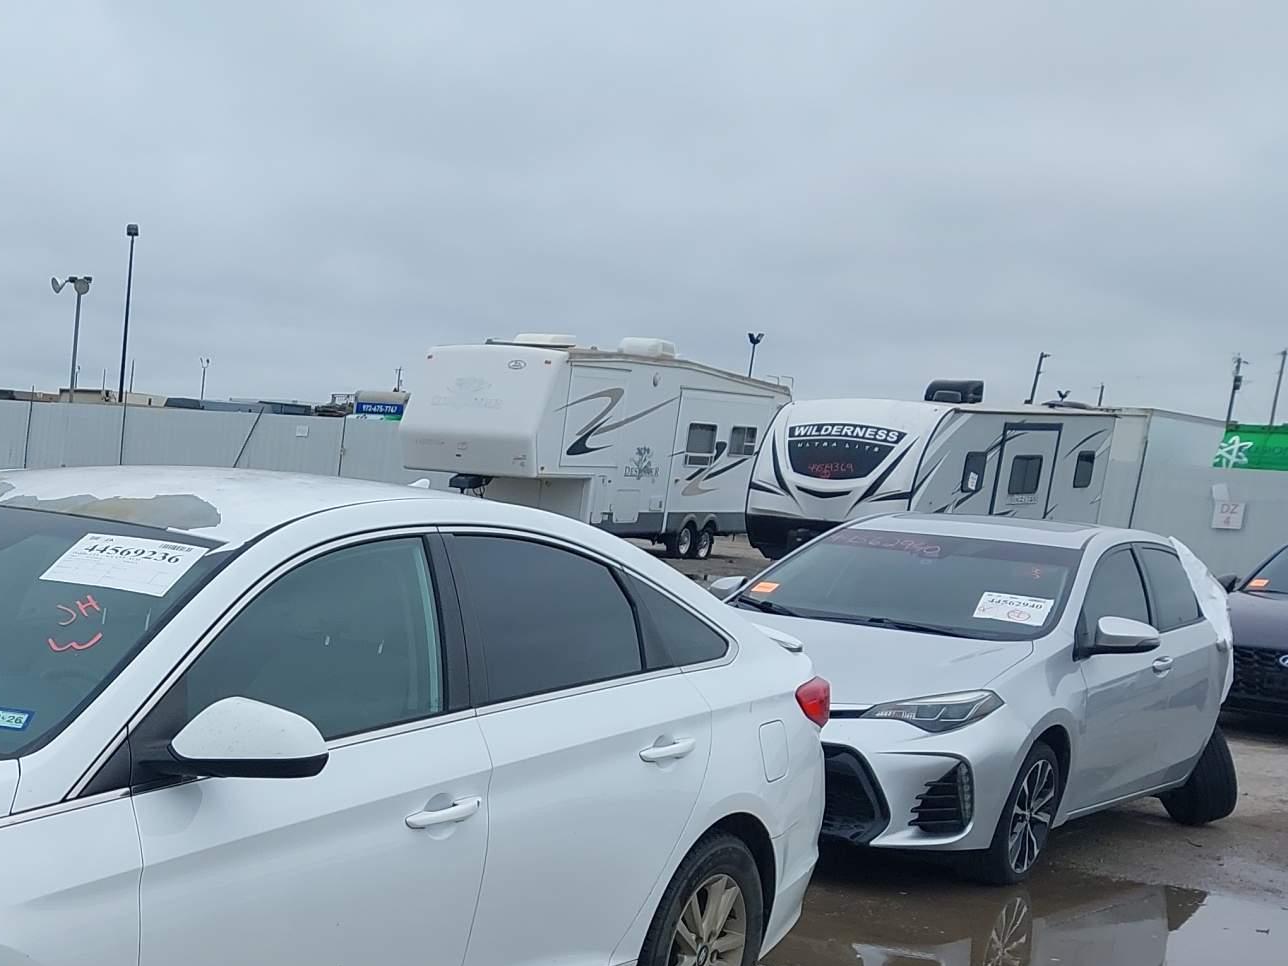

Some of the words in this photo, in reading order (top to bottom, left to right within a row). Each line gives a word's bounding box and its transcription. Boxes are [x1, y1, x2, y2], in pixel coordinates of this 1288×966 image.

[794, 425, 899, 442] WILDERNESS
[1220, 503, 1240, 514] DZ
[84, 543, 183, 564] 44569236
[987, 598, 1044, 610] 44562940
[5, 715, 24, 724] 26
